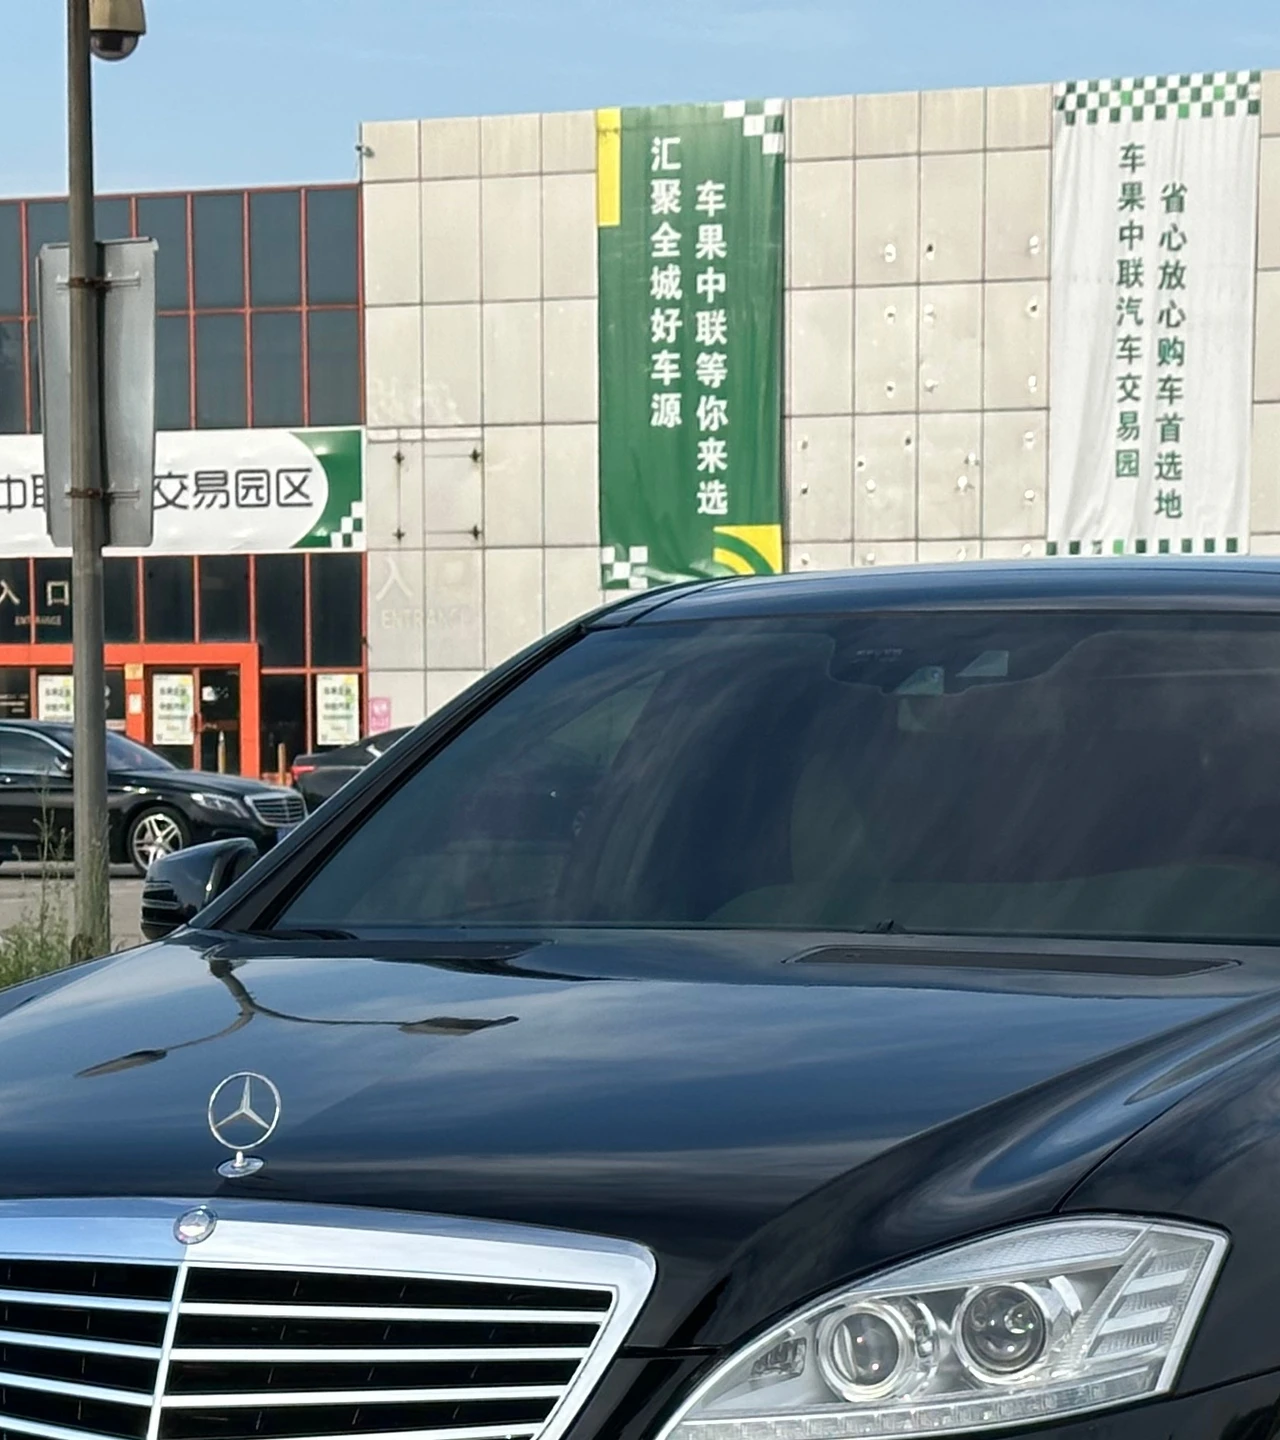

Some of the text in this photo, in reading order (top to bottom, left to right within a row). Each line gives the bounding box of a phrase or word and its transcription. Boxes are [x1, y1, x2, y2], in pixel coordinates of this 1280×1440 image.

[649, 136, 682, 428] 汇聚全城好车源
[694, 180, 729, 515] 车果中联等你来选
[1115, 142, 1147, 478] 车果中联汽车交易园
[1154, 182, 1189, 520] 省心放心购车首选地
